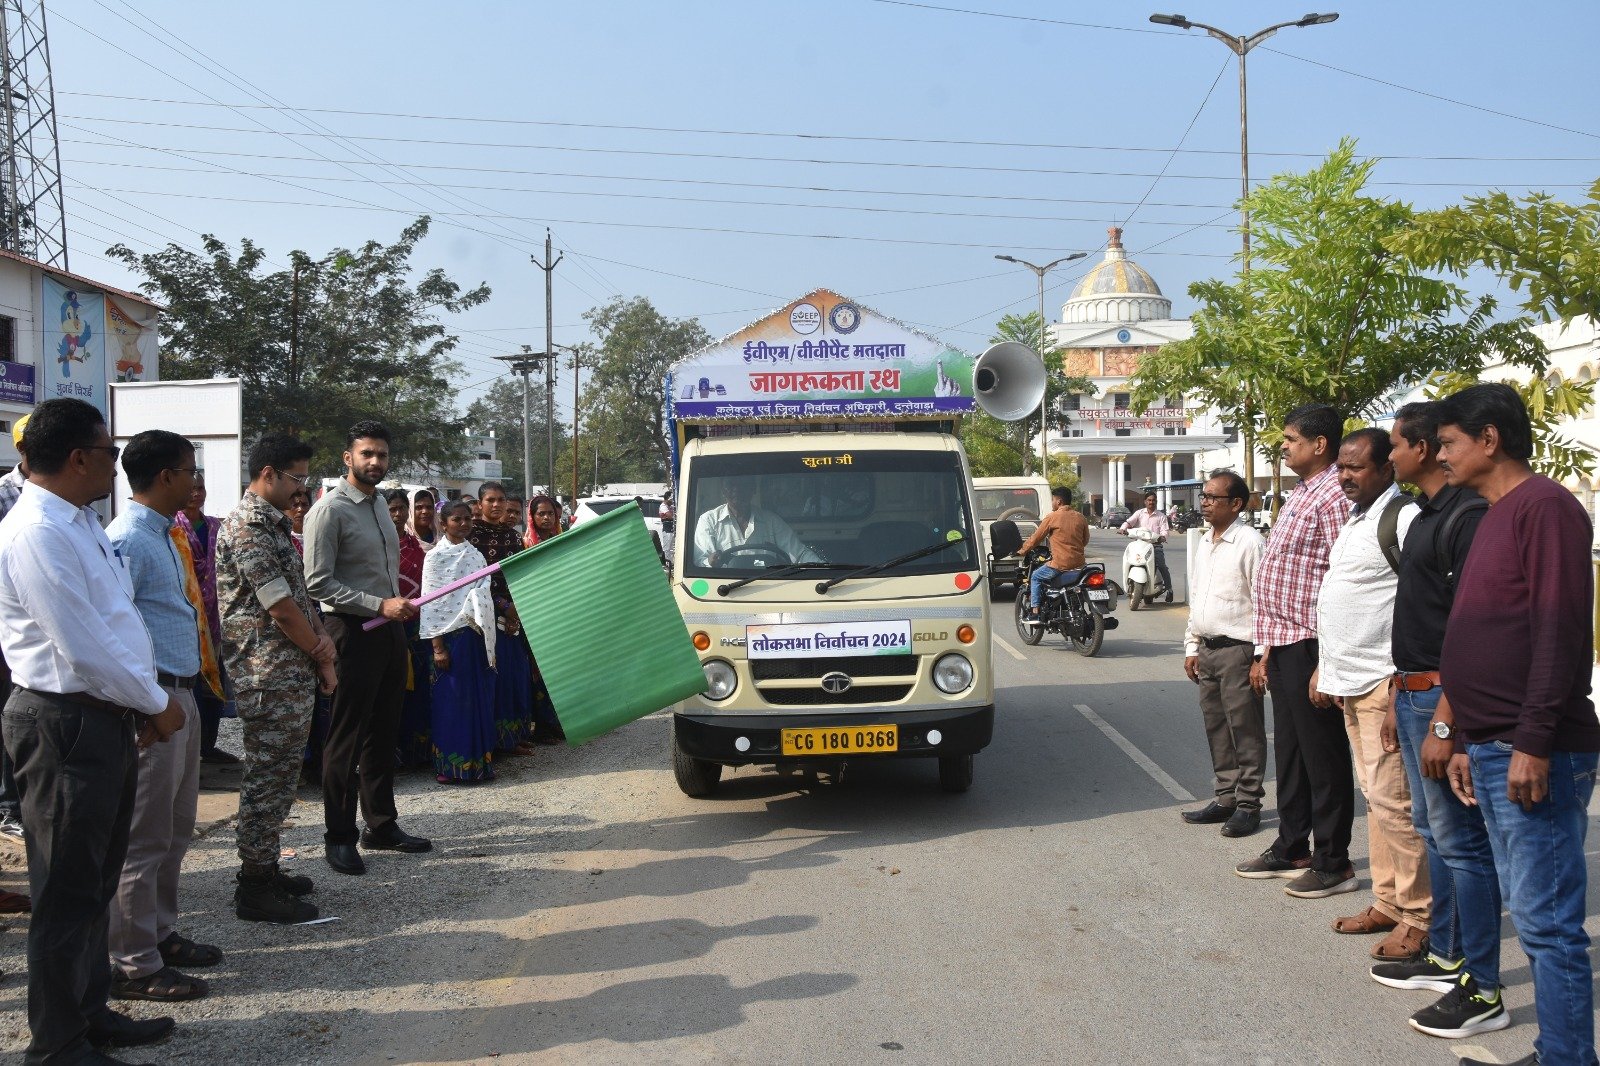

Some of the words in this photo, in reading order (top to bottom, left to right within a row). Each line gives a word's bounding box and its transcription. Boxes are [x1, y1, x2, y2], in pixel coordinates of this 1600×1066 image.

[852, 344, 906, 360] मतदाता
[749, 371, 865, 393] जागरूकता
[869, 368, 901, 391] रथ
[758, 403, 771, 414] एवं
[804, 402, 840, 414] निर्वाचन
[752, 634, 811, 652] लोकसभा
[814, 631, 869, 650] निर्वाचन
[872, 632, 907, 648] 2024
[913, 631, 949, 642] GOLD
[794, 733, 815, 750] CG
[821, 732, 850, 750] 18Q
[855, 730, 896, 748] 0368
